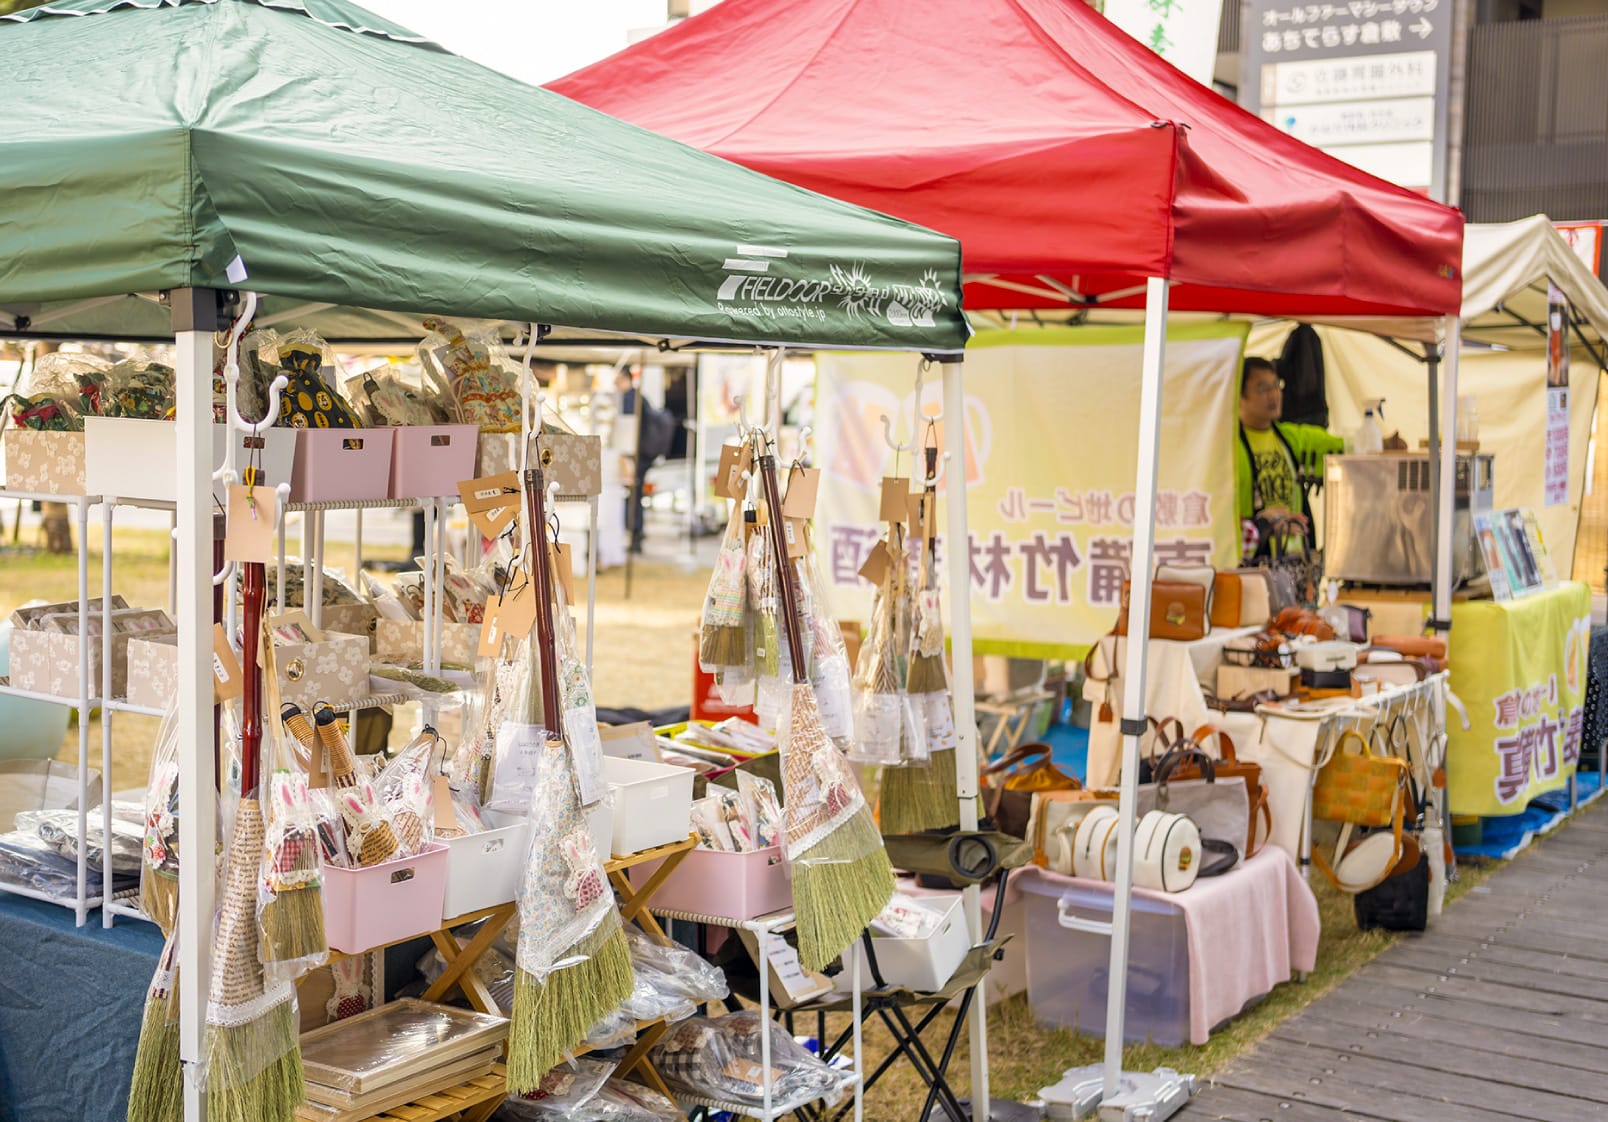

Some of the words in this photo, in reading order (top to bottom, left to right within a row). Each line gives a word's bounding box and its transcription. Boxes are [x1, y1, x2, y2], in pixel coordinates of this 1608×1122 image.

[741, 276, 831, 303] FIELDOOR
[718, 302, 761, 317] Powered
[761, 302, 776, 319] by
